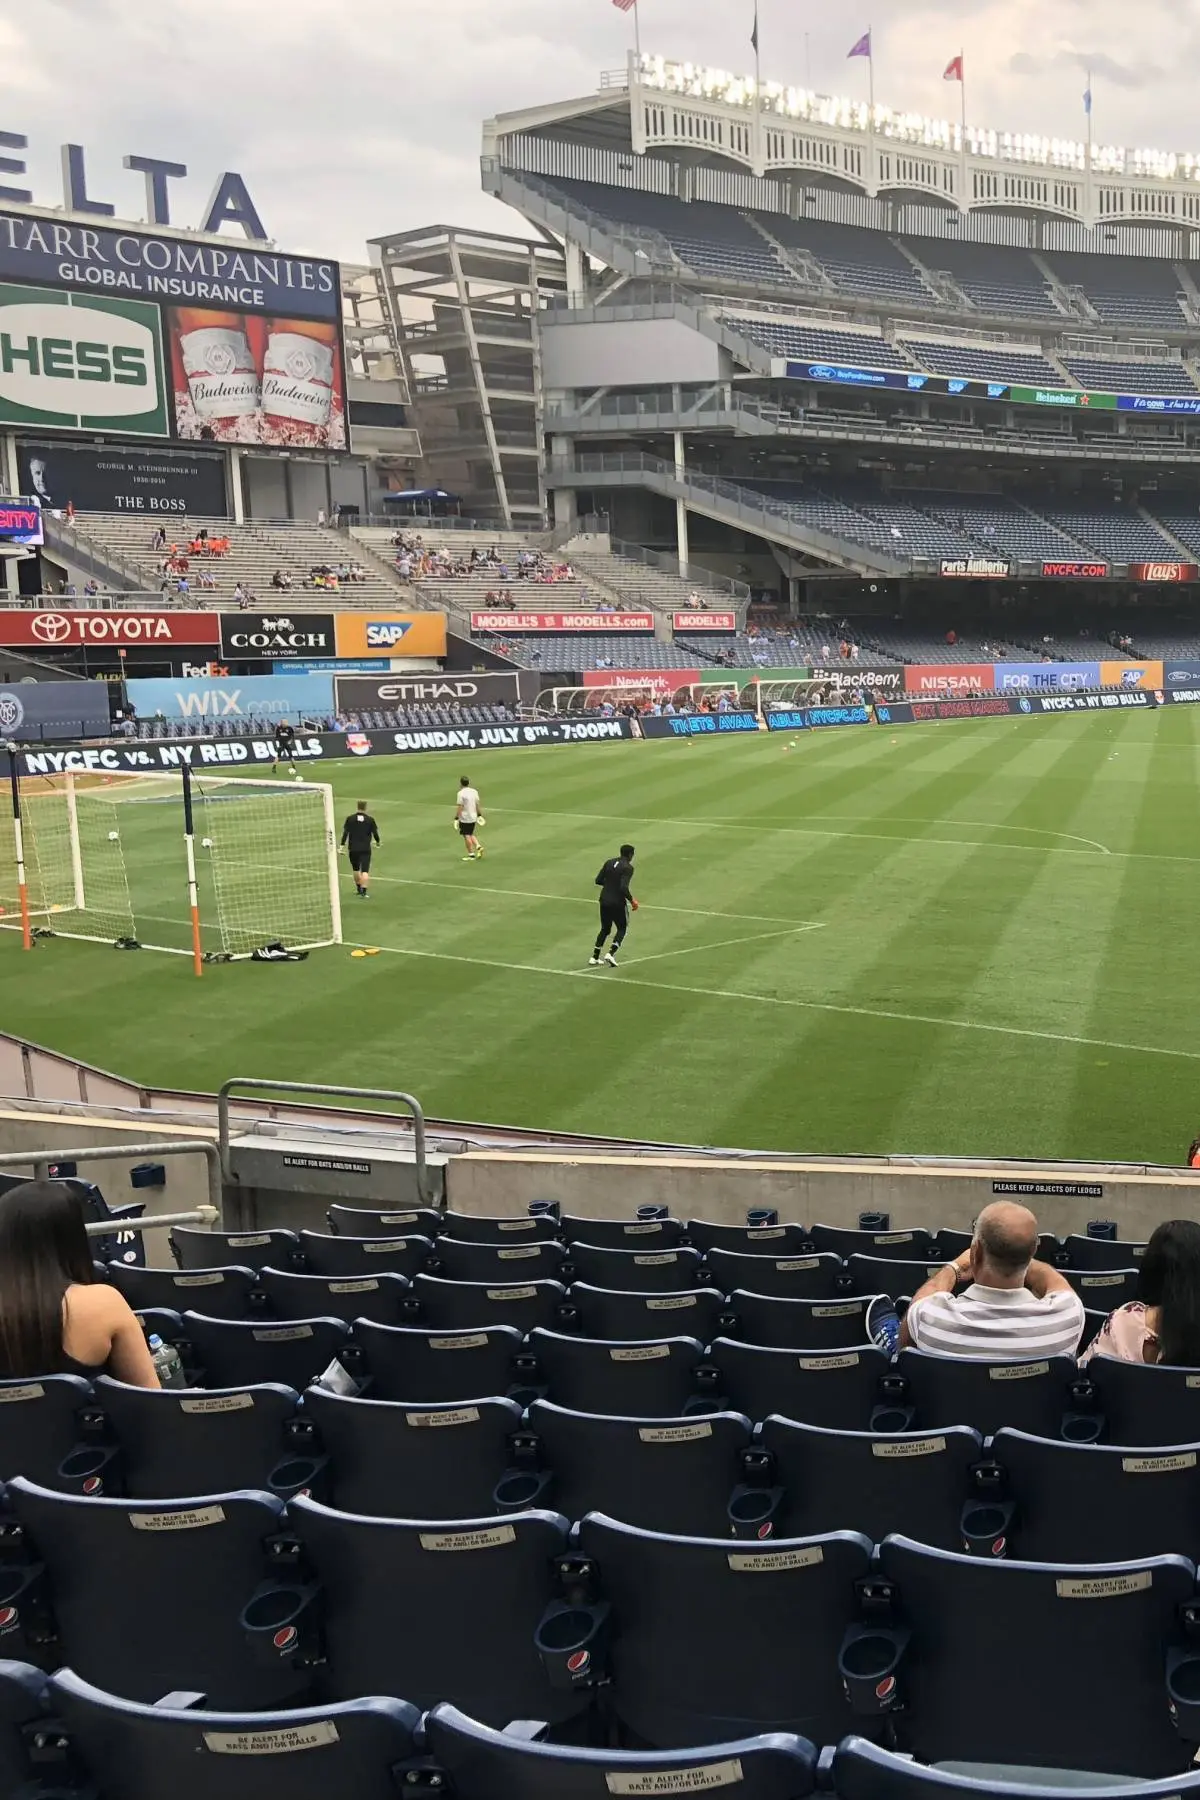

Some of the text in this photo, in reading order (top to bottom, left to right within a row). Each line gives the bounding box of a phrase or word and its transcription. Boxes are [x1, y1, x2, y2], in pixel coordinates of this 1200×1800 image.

[0, 216, 334, 292] TARR COMPANIES
[59, 263, 265, 306] GLOBAL INSURANCE
[1, 332, 148, 386] HESS
[115, 495, 186, 510] THE BOSS
[941, 559, 1009, 574] Parts Authority
[1043, 563, 1106, 577] NYCFC.COM
[74, 617, 172, 638] TOYOTA
[477, 615, 648, 628] MODELL'S MODELLS.com
[679, 615, 729, 628] MODELL'S
[230, 633, 327, 648] COACH
[367, 626, 403, 644] SAP
[181, 662, 230, 677] FedEx
[921, 676, 981, 689] NISSAN
[1003, 674, 1029, 688] FOR
[1033, 674, 1057, 687] THE
[377, 681, 478, 702] ETIHAD
[175, 689, 290, 717] WIXcom
[1041, 697, 1074, 710] NYCFC
[1086, 695, 1100, 707] NY
[1100, 694, 1118, 706] RED
[1119, 693, 1147, 705] BULLS
[394, 729, 476, 750] SUNDAY,
[479, 726, 519, 746] JULY
[524, 725, 549, 742] 8TH
[561, 721, 622, 740] 7:00PM
[24, 738, 323, 774] NYCFC vs. NY RED BULS
[292, 1158, 307, 1166] ALERT
[994, 1183, 1017, 1191] PLEASE
[1018, 1184, 1034, 1192] KEEP
[1036, 1185, 1064, 1193] OBJECTS
[1078, 1186, 1101, 1195] LEDGES
[251, 1741, 287, 1749] AND/OR
[290, 1736, 317, 1747] BALLS
[252, 1735, 278, 1743] ALERT
[281, 1732, 298, 1740] FOR
[655, 1781, 691, 1790] AND/OR
[693, 1775, 721, 1785] BALLS
[657, 1774, 683, 1783] ALERT
[687, 1771, 704, 1780] FOR
